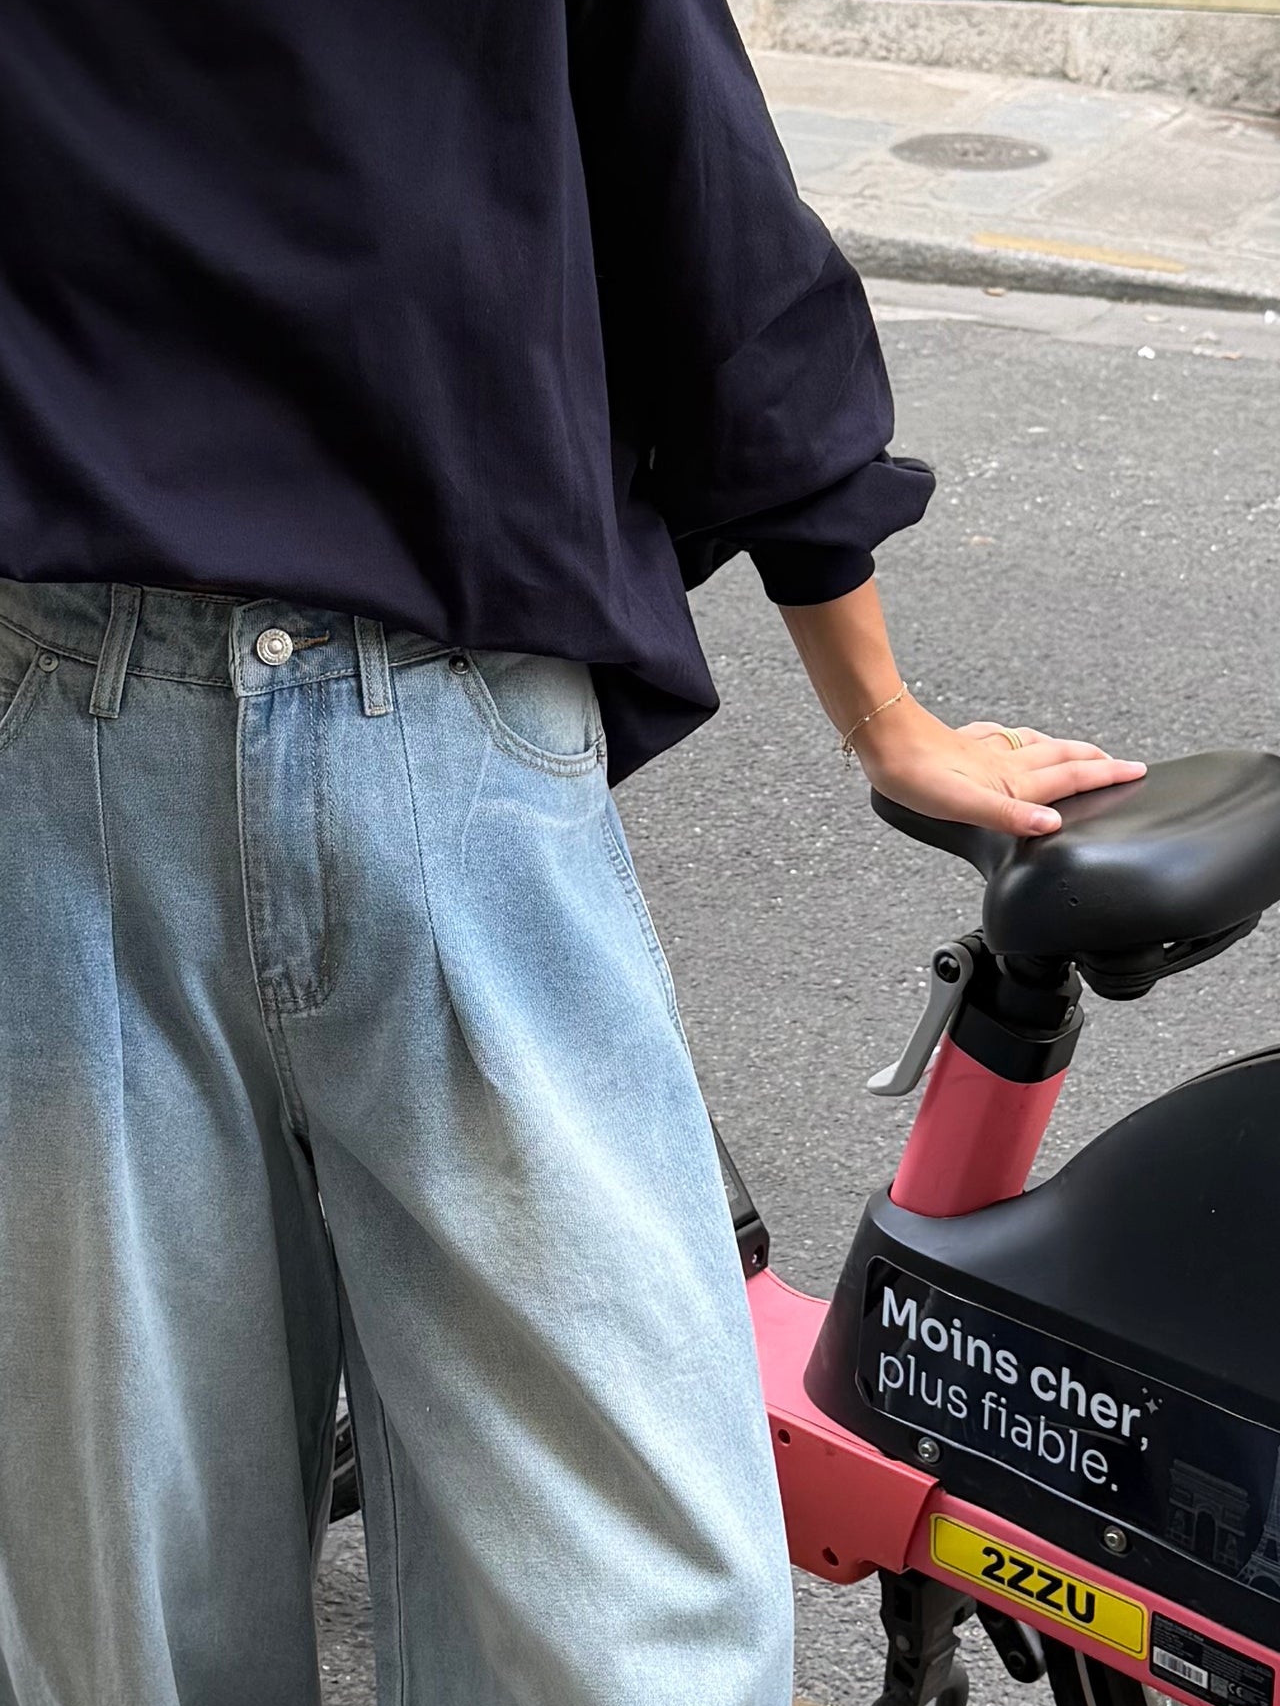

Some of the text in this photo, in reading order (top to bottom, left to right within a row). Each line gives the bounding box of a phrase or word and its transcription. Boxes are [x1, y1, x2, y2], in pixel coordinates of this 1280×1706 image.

[877, 1351, 1120, 1492] plus fiable.
[880, 1286, 1151, 1452] Moins cher,
[981, 1545, 1096, 1625] 2ZZU
